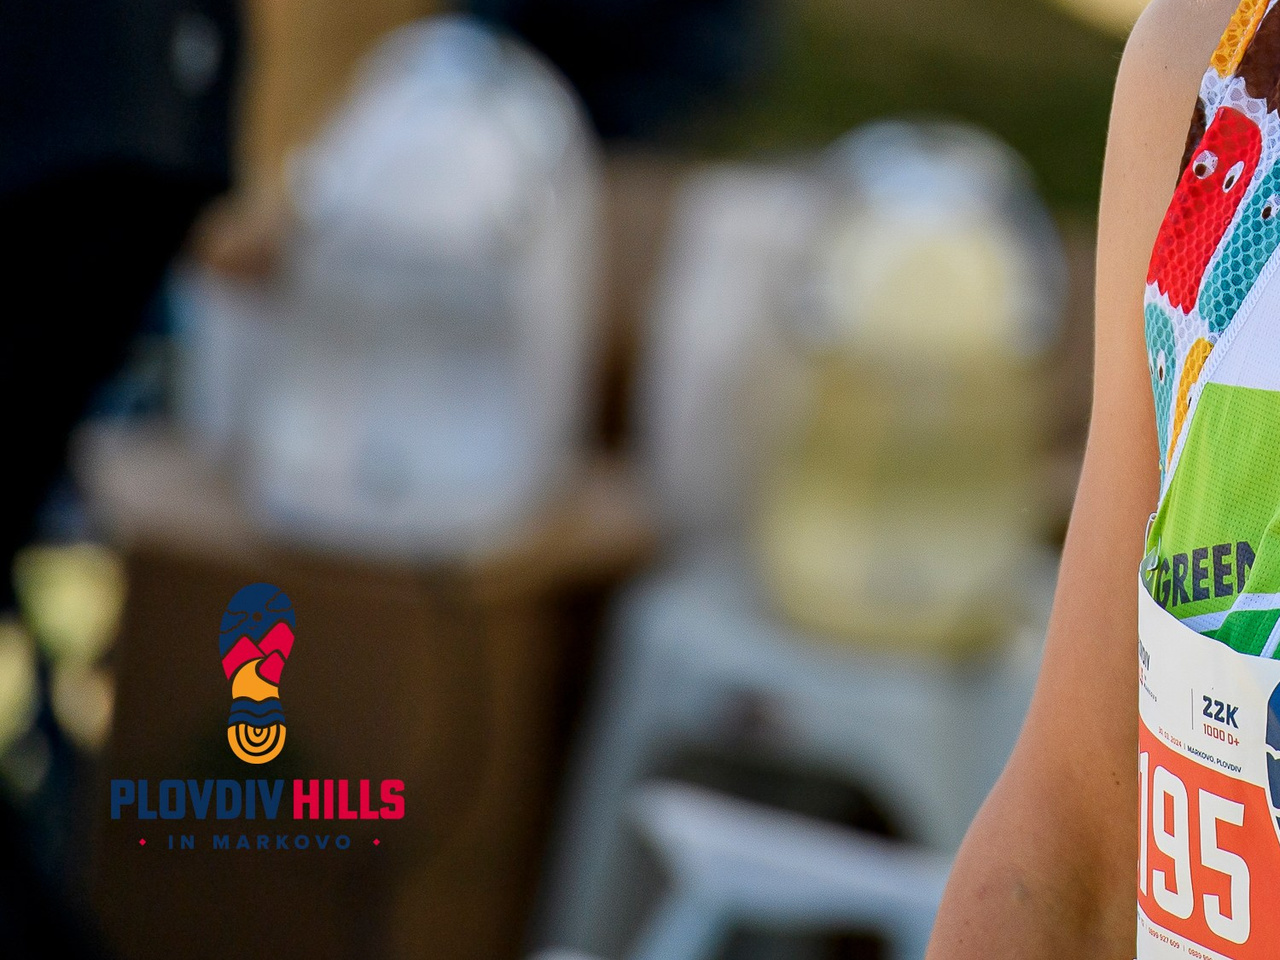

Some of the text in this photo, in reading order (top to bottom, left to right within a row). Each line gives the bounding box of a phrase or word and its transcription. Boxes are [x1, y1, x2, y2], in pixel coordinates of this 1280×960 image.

[1202, 695, 1239, 729] 22K
[1203, 723, 1226, 742] 1000
[1139, 751, 1250, 945] 195
